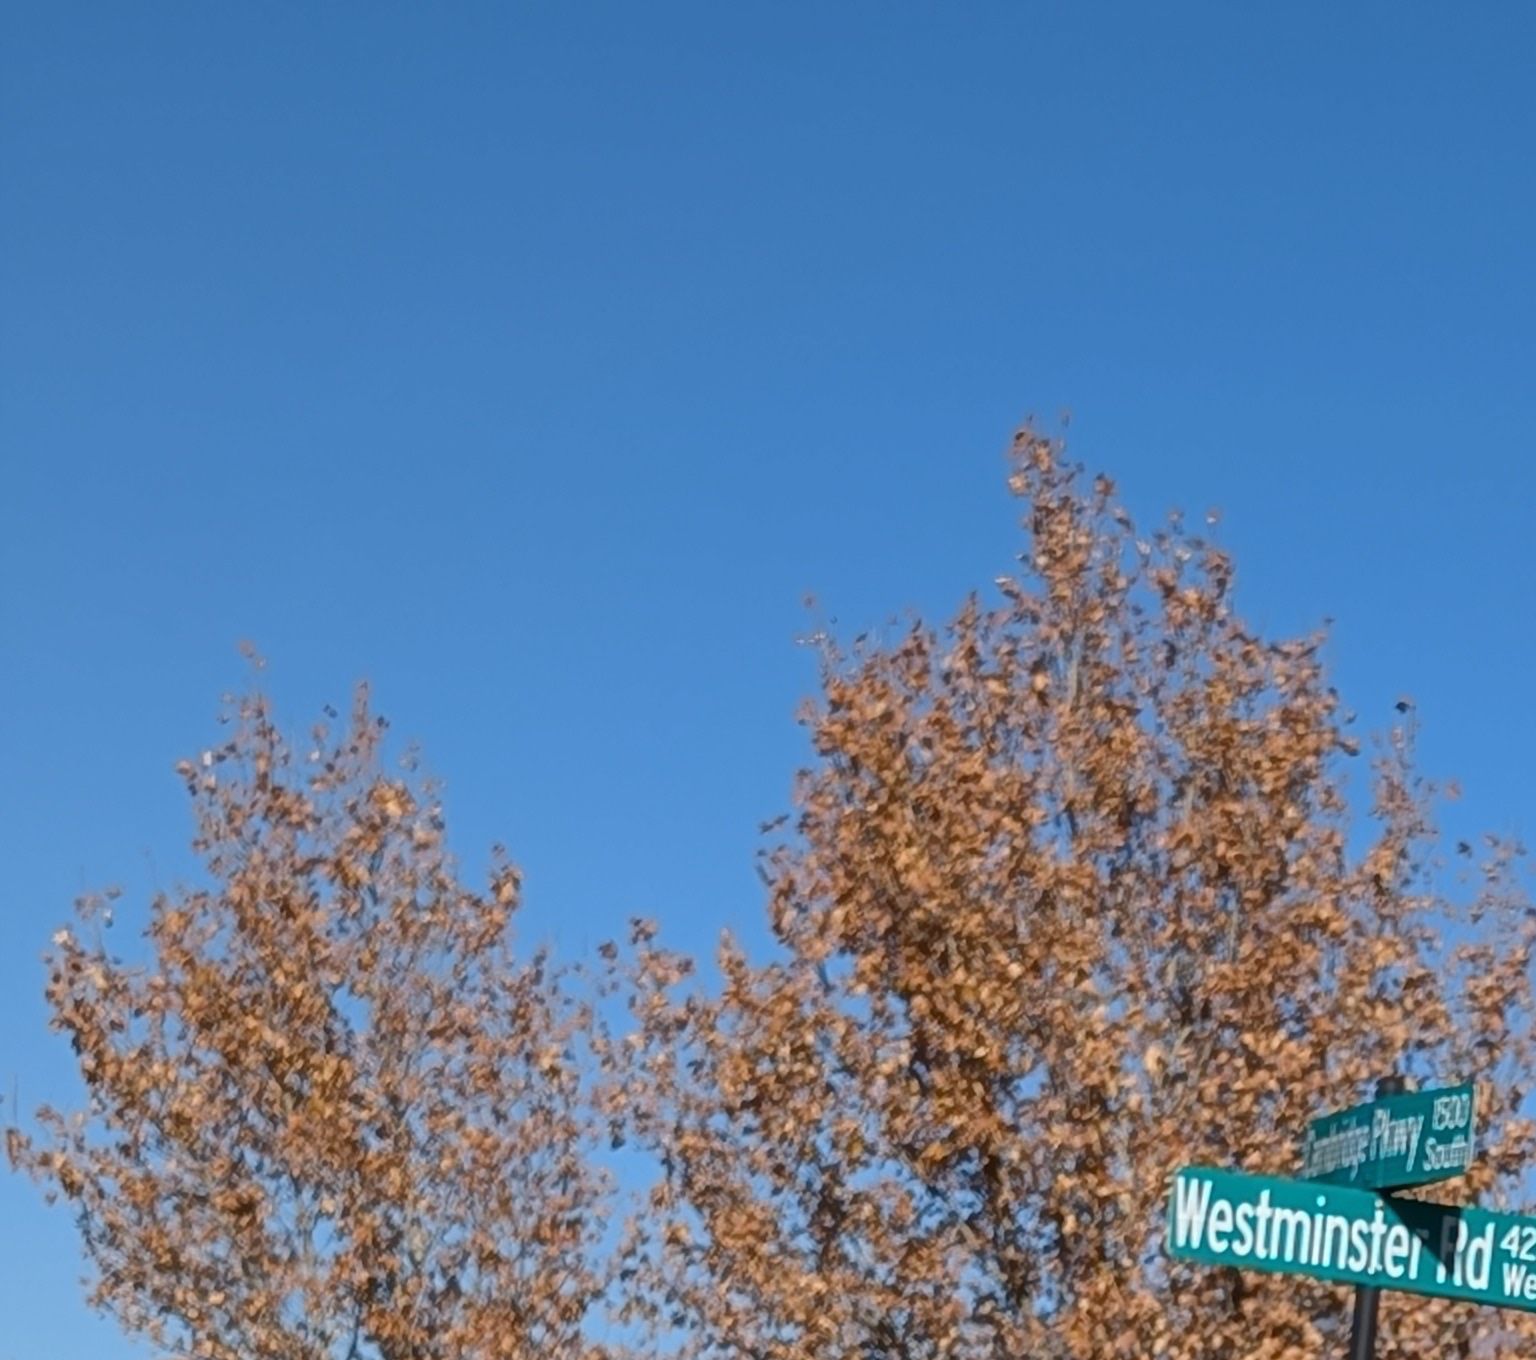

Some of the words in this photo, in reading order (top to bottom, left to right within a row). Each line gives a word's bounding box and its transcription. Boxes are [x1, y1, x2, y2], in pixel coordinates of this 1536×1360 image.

[1423, 1134, 1473, 1172] South
[1176, 1177, 1426, 1279] Westminster
[1437, 1217, 1496, 1289] Rd
